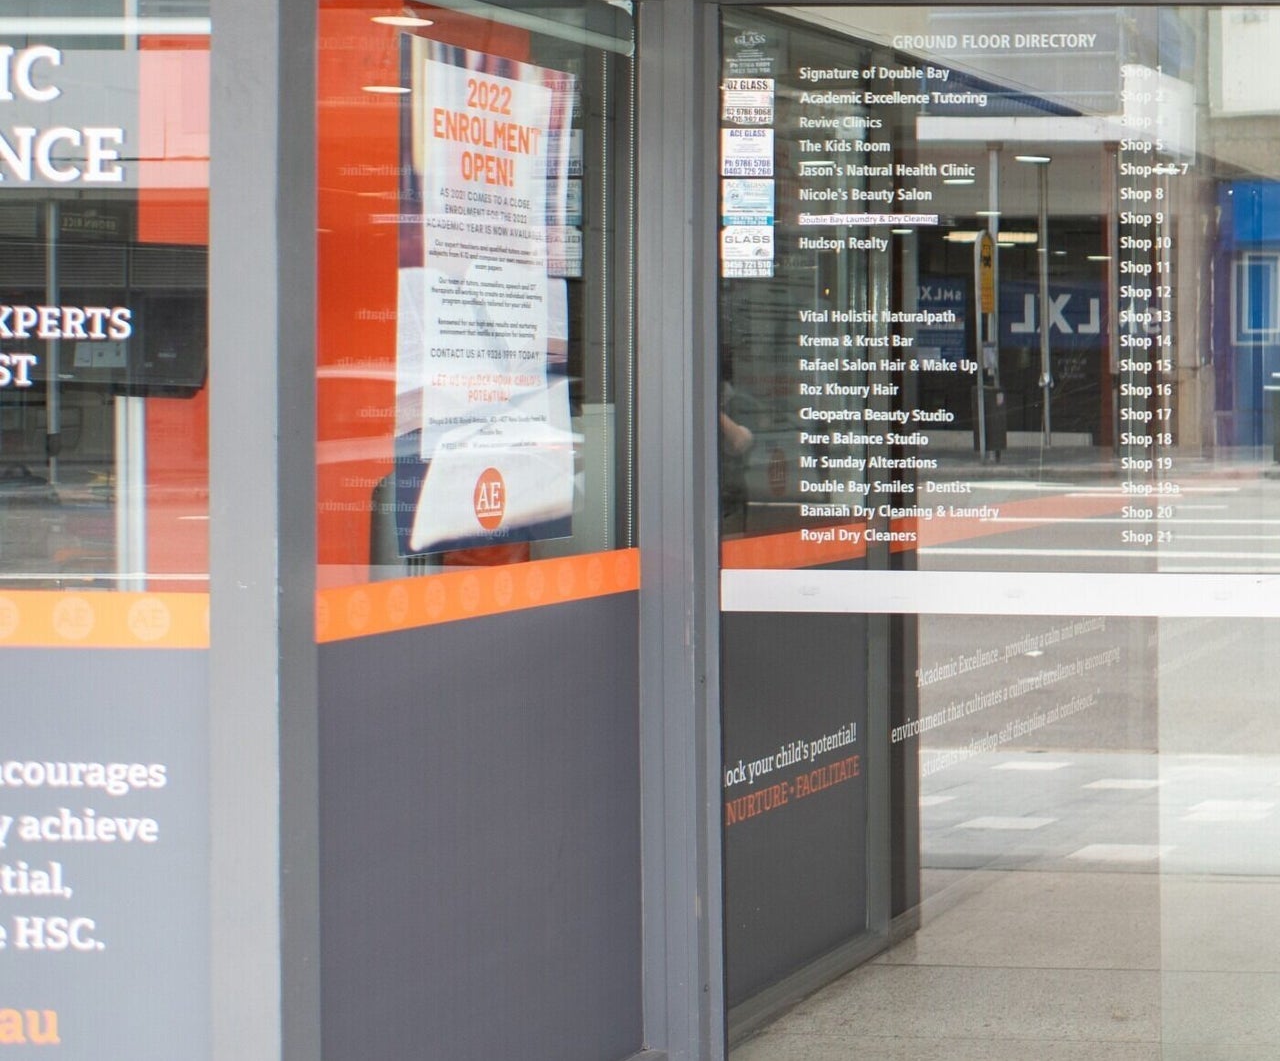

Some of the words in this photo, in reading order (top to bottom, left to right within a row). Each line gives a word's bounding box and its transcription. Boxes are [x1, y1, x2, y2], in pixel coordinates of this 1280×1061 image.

[892, 35, 957, 49] GROUND
[963, 34, 1010, 48] FLOOR
[1015, 34, 1097, 48] DIRECTORY
[799, 67, 862, 82] Signature
[863, 67, 877, 79] of
[879, 67, 924, 79] Double
[927, 67, 950, 82] Bay
[740, 80, 768, 90] GLASS
[467, 78, 512, 115] 2022
[800, 92, 862, 105] Academic
[865, 92, 930, 105] Excellence
[933, 92, 987, 107] Tutoring
[799, 117, 840, 128] Revive
[843, 117, 882, 128] Clinics
[433, 107, 542, 155] ENROLMENT
[800, 140, 822, 152] The
[825, 140, 852, 152] Kids
[855, 140, 890, 152] Room
[461, 151, 514, 187] OPEN!
[799, 164, 843, 176] Jason's
[847, 164, 893, 176] Natural
[896, 164, 937, 176] Health
[941, 164, 976, 176] Clinic
[799, 188, 848, 201] Nicole's
[852, 188, 895, 203] Beauty
[898, 188, 932, 201] Salon
[800, 216, 827, 224] Double
[829, 216, 844, 224] Bay
[846, 216, 877, 224] Laundry
[888, 216, 903, 224] Dry
[904, 216, 938, 224] Cleaning
[725, 235, 771, 244] GLASS
[799, 237, 845, 250] Hudson
[850, 237, 888, 252] Realty
[1120, 286, 1152, 300] Shop
[1156, 286, 1171, 297] 12
[800, 310, 828, 322] Vital
[832, 310, 878, 322] Holistic
[881, 310, 956, 325] Naturalpath
[800, 335, 839, 347] Krema
[843, 335, 853, 347] &
[856, 335, 890, 347] Krust
[893, 335, 913, 347] Bar
[431, 348, 464, 358] CONTACT
[466, 349, 474, 358] US
[477, 349, 485, 358] AT
[800, 359, 839, 371] Rafael
[842, 359, 877, 371] Salon
[880, 359, 906, 371] Hair
[910, 359, 919, 371] &
[923, 359, 957, 371] Make
[961, 360, 978, 374] Up
[800, 384, 822, 395] Roz
[826, 383, 870, 398] Khoury
[873, 384, 899, 395] Hair
[800, 407, 861, 423] Cleopatra
[864, 409, 910, 424] Beauty
[912, 409, 954, 422] Studio
[1120, 408, 1152, 423] Shop
[1157, 408, 1172, 420] 17
[800, 432, 830, 445] Pure
[833, 432, 883, 445] Balance
[886, 432, 929, 445] Studio
[800, 456, 818, 468] Mr
[821, 456, 866, 471] Sunday
[868, 456, 938, 469] Alterations
[800, 481, 845, 493] Double
[849, 481, 871, 495] Bay
[873, 481, 914, 493] Smiles
[926, 481, 971, 493] Dentist
[476, 481, 501, 511] AE
[801, 505, 850, 517] Banaiah
[853, 505, 876, 519] Dry
[879, 505, 933, 520] Cleaning
[937, 505, 946, 517] &
[949, 505, 1000, 520] Laundry
[801, 529, 835, 544] Royal
[839, 529, 864, 544] Dry
[864, 529, 917, 541] Cleaners
[748, 754, 775, 784] your
[776, 739, 808, 768] child's
[810, 722, 857, 762] potential!
[0, 760, 167, 796] courages
[725, 781, 789, 827] NURTURE
[795, 754, 860, 798] FACILITATE
[19, 807, 159, 842] achieve
[0, 860, 73, 900] tial,
[14, 915, 106, 951] HSC.
